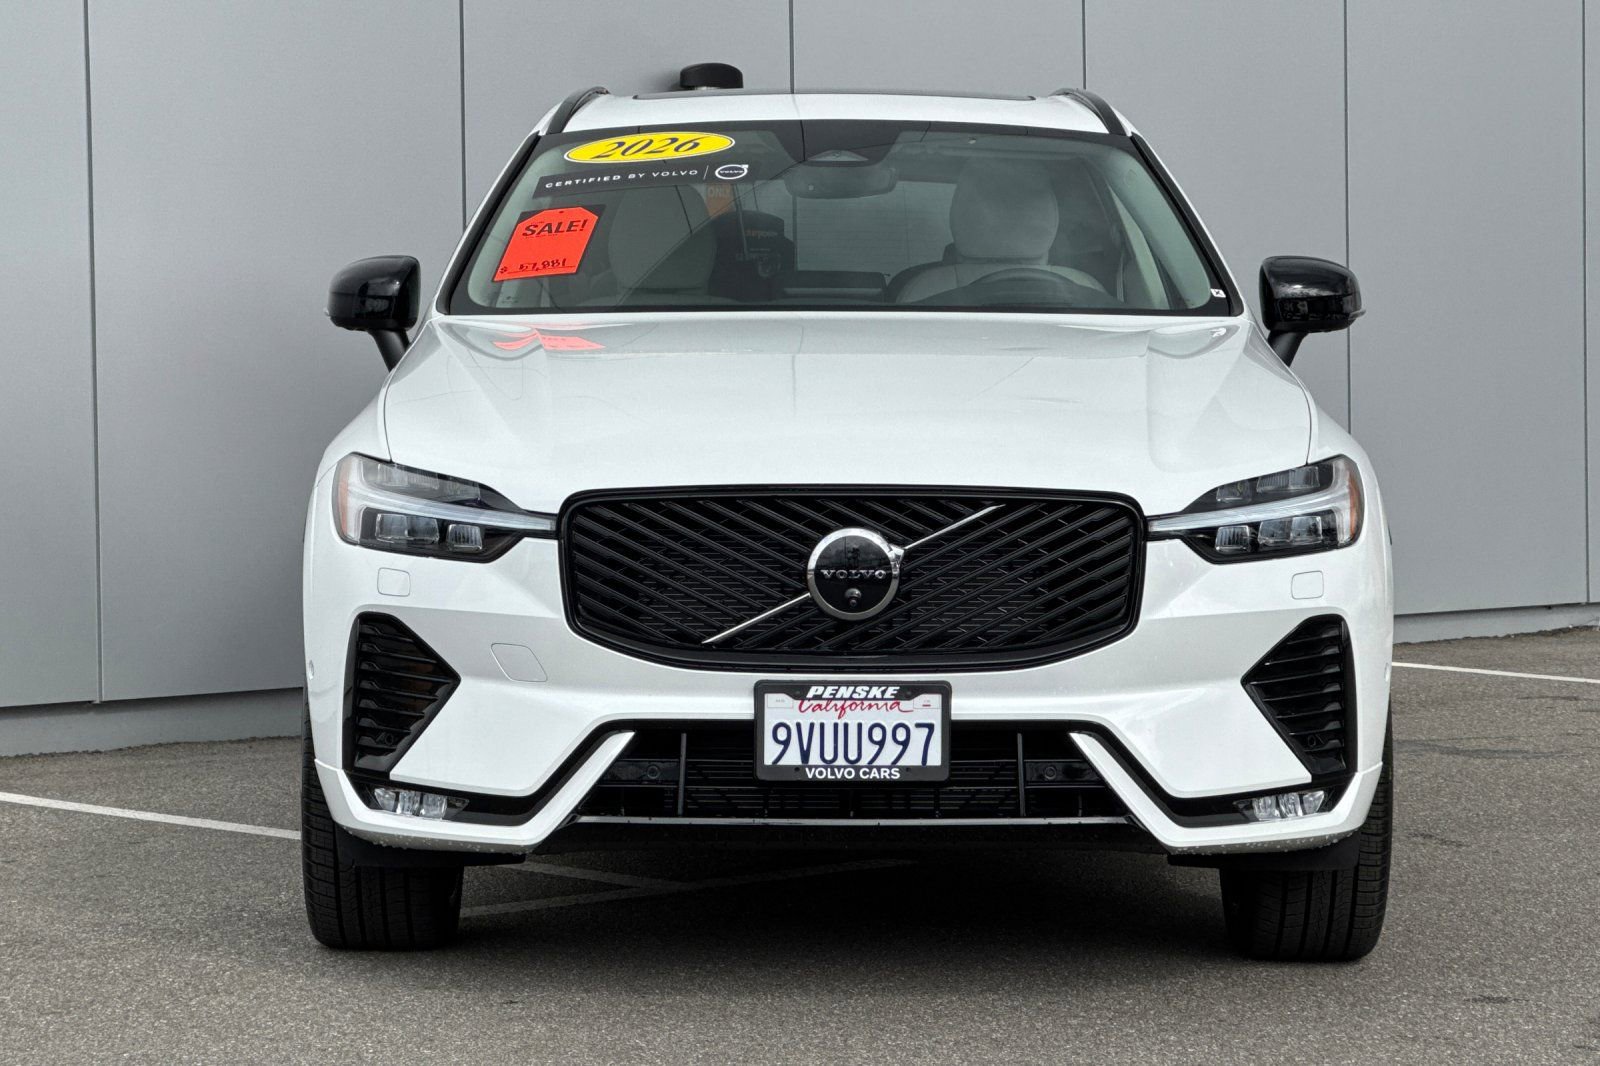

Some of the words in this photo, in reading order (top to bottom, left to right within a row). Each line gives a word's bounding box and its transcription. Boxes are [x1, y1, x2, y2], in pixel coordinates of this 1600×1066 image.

[590, 135, 702, 160] 2026
[545, 174, 621, 189] CERTIFIED
[628, 171, 646, 179] BY
[652, 168, 699, 178] VOLVO
[522, 219, 588, 237] SALE!
[820, 569, 887, 580] VOLVO
[805, 685, 901, 699] PENSKE
[798, 699, 914, 720] California
[771, 721, 935, 767] 9VUU997
[805, 767, 856, 780] VOLVO
[859, 767, 901, 780] CARS
